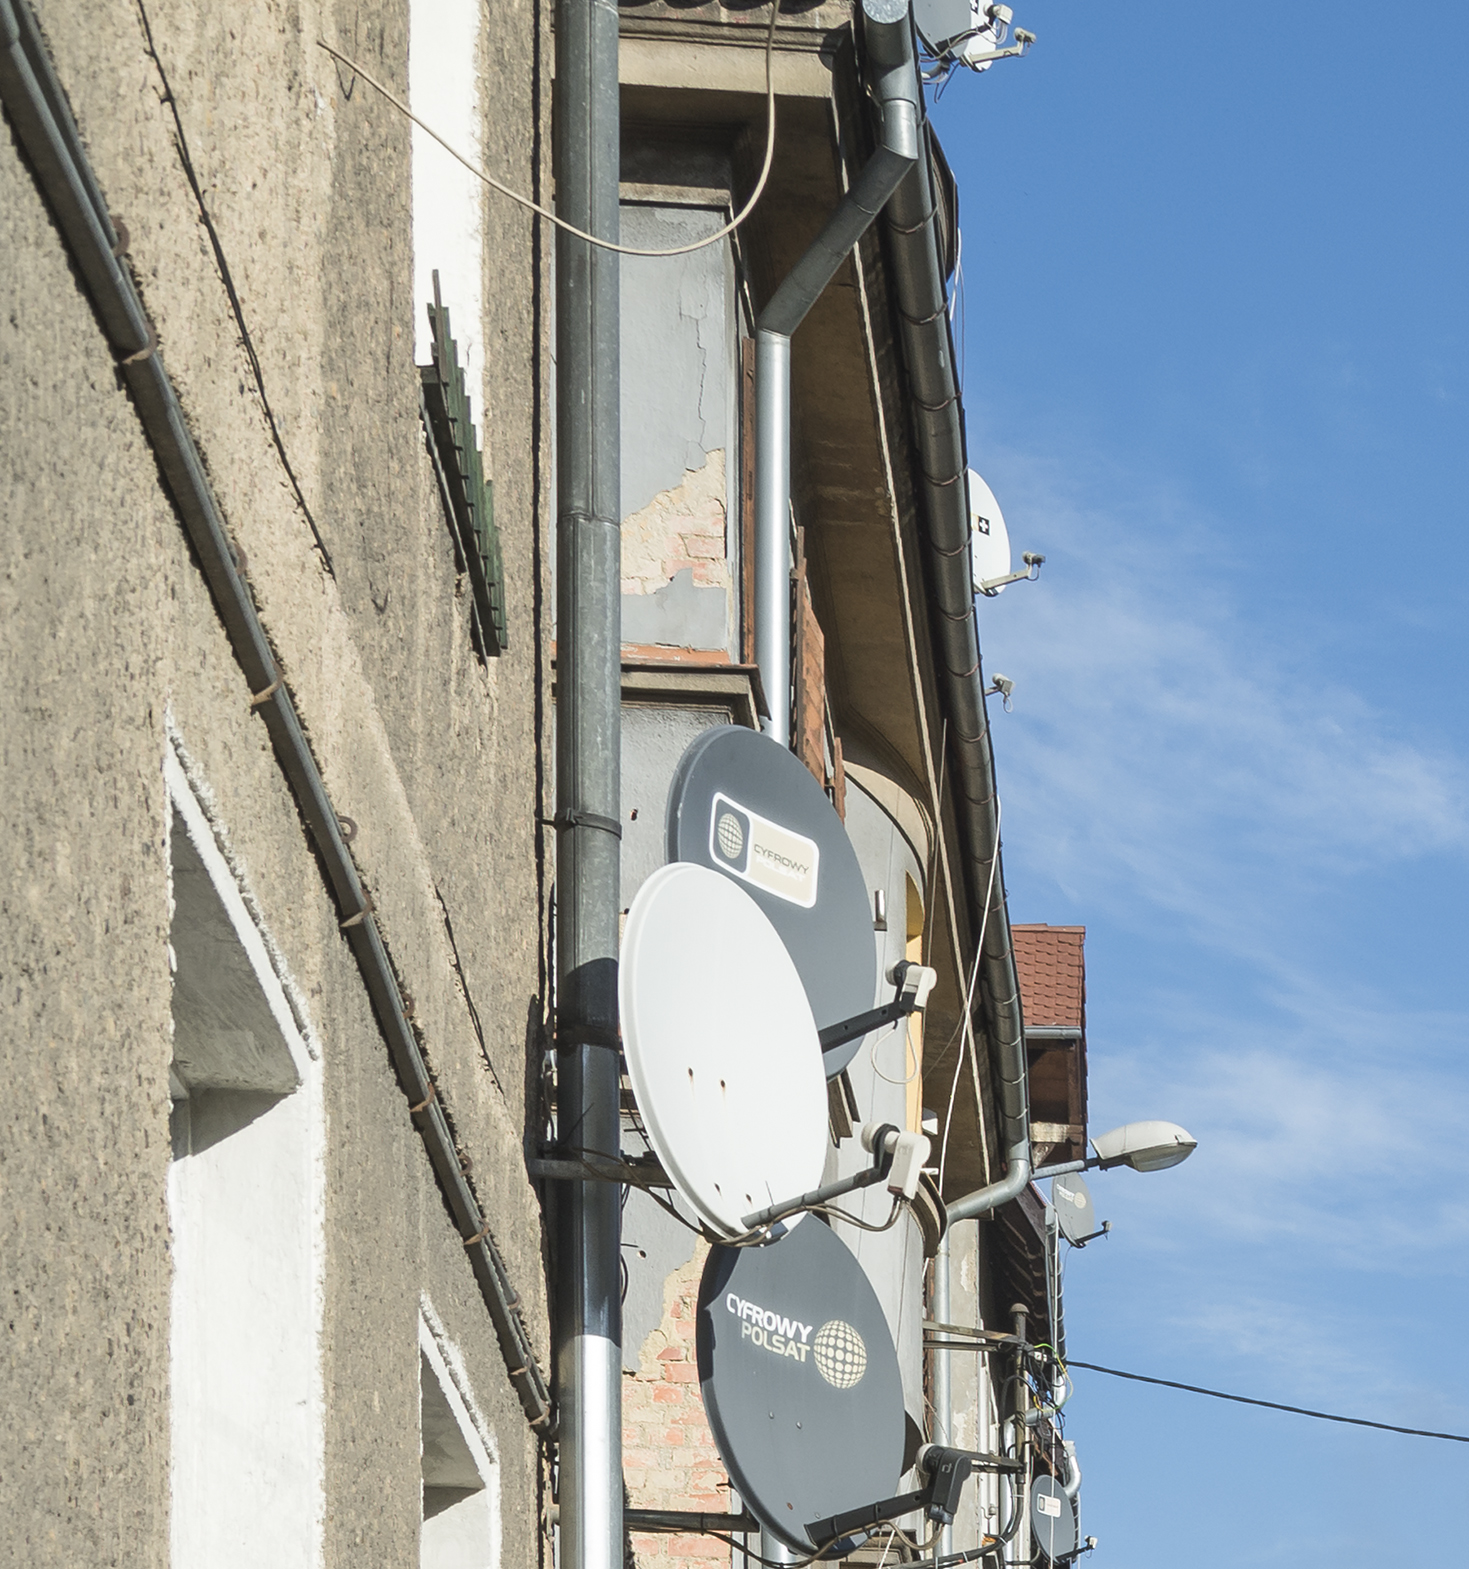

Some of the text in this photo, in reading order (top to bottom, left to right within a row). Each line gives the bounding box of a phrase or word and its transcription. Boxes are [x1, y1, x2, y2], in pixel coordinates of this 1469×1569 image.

[753, 843, 809, 874] CYFROWY
[755, 855, 806, 882] POLSAT
[726, 1293, 813, 1343] CYFROWY
[741, 1321, 811, 1363] POLSAT
